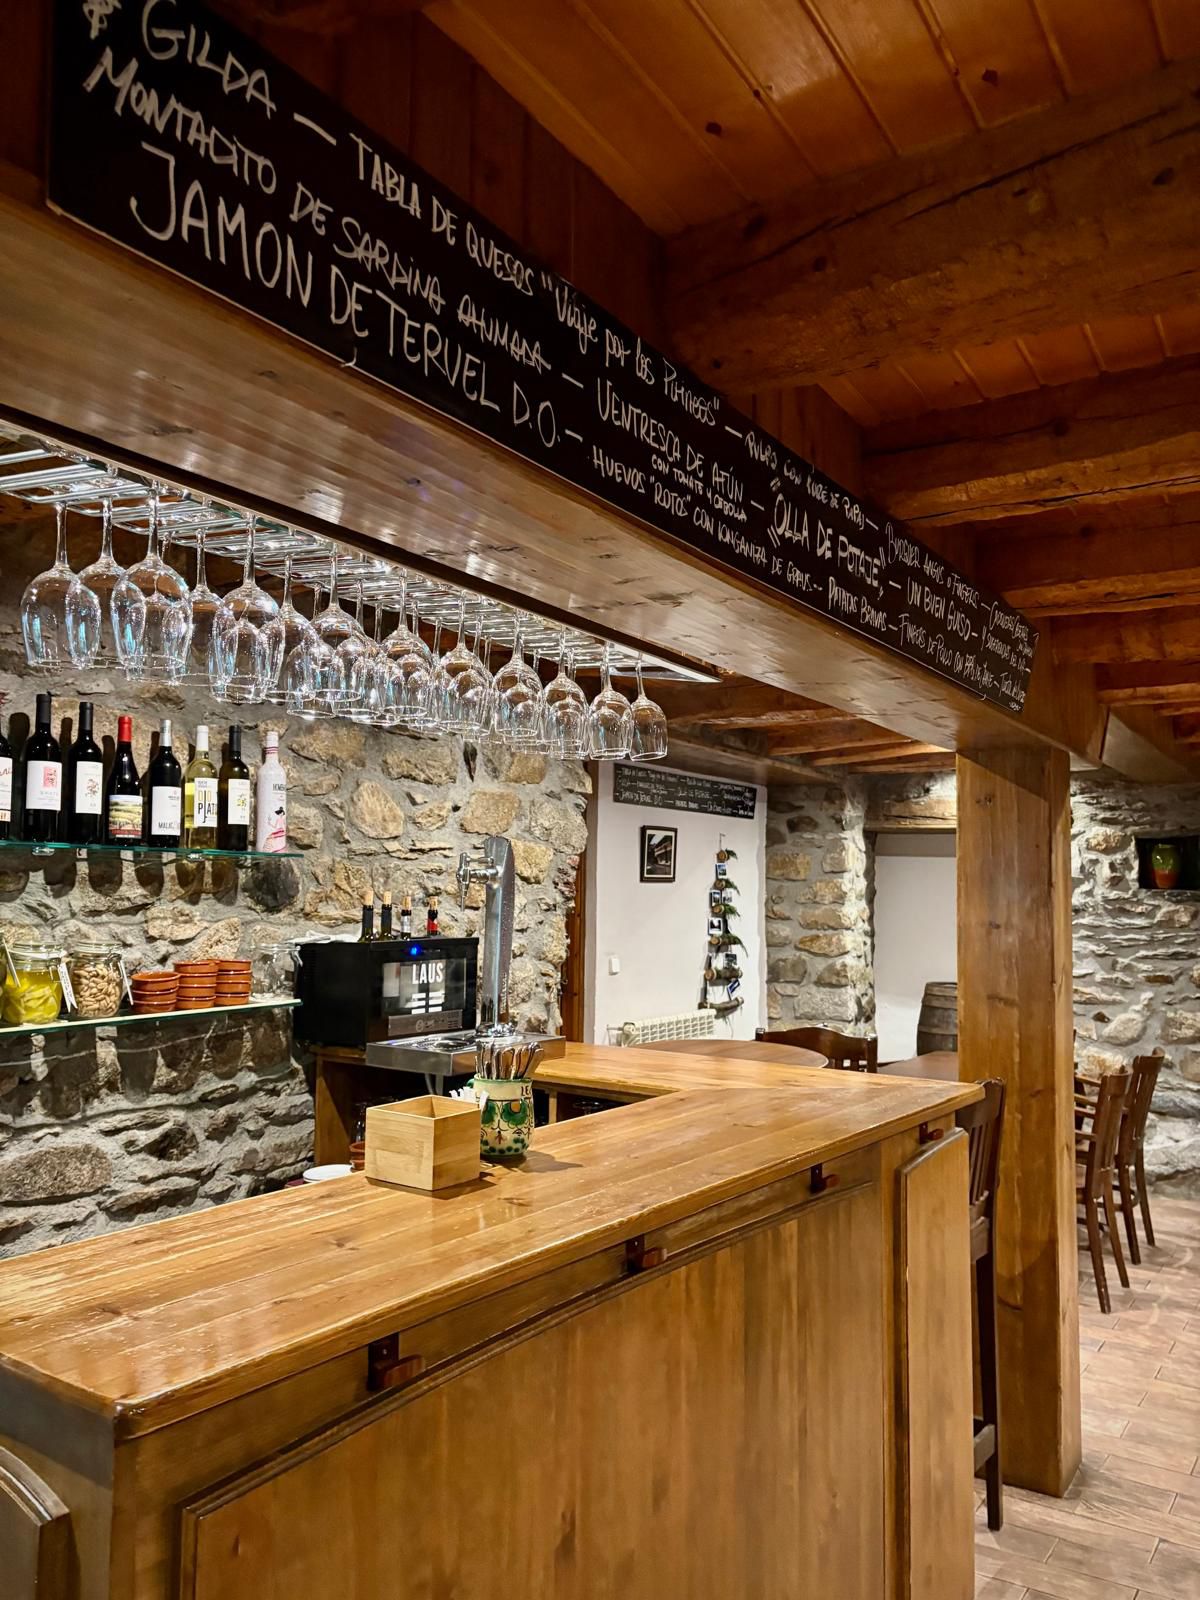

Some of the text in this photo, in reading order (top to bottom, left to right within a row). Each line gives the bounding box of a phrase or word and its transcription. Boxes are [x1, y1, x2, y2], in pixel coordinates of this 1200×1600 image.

[83, 46, 276, 194] MONTADITO
[289, 182, 333, 236] DE
[333, 216, 446, 315] SARDINA
[686, 444, 704, 479] DE
[816, 519, 833, 560] DE
[907, 576, 922, 607] UN
[924, 586, 946, 619] BUEN
[947, 600, 971, 641] GUISO
[130, 141, 313, 308] JAMON
[330, 264, 372, 338] DE
[593, 445, 646, 494] HUEVOS
[693, 506, 714, 536] CON
[771, 555, 783, 576] DE
[142, 0, 276, 119] GILDA
[349, 133, 422, 219] TABLA
[431, 196, 458, 246] DE
[466, 222, 534, 296] QUESOS
[604, 328, 631, 367] por
[636, 337, 655, 385] los
[652, 454, 670, 479] CON
[412, 962, 443, 985] LAUS
